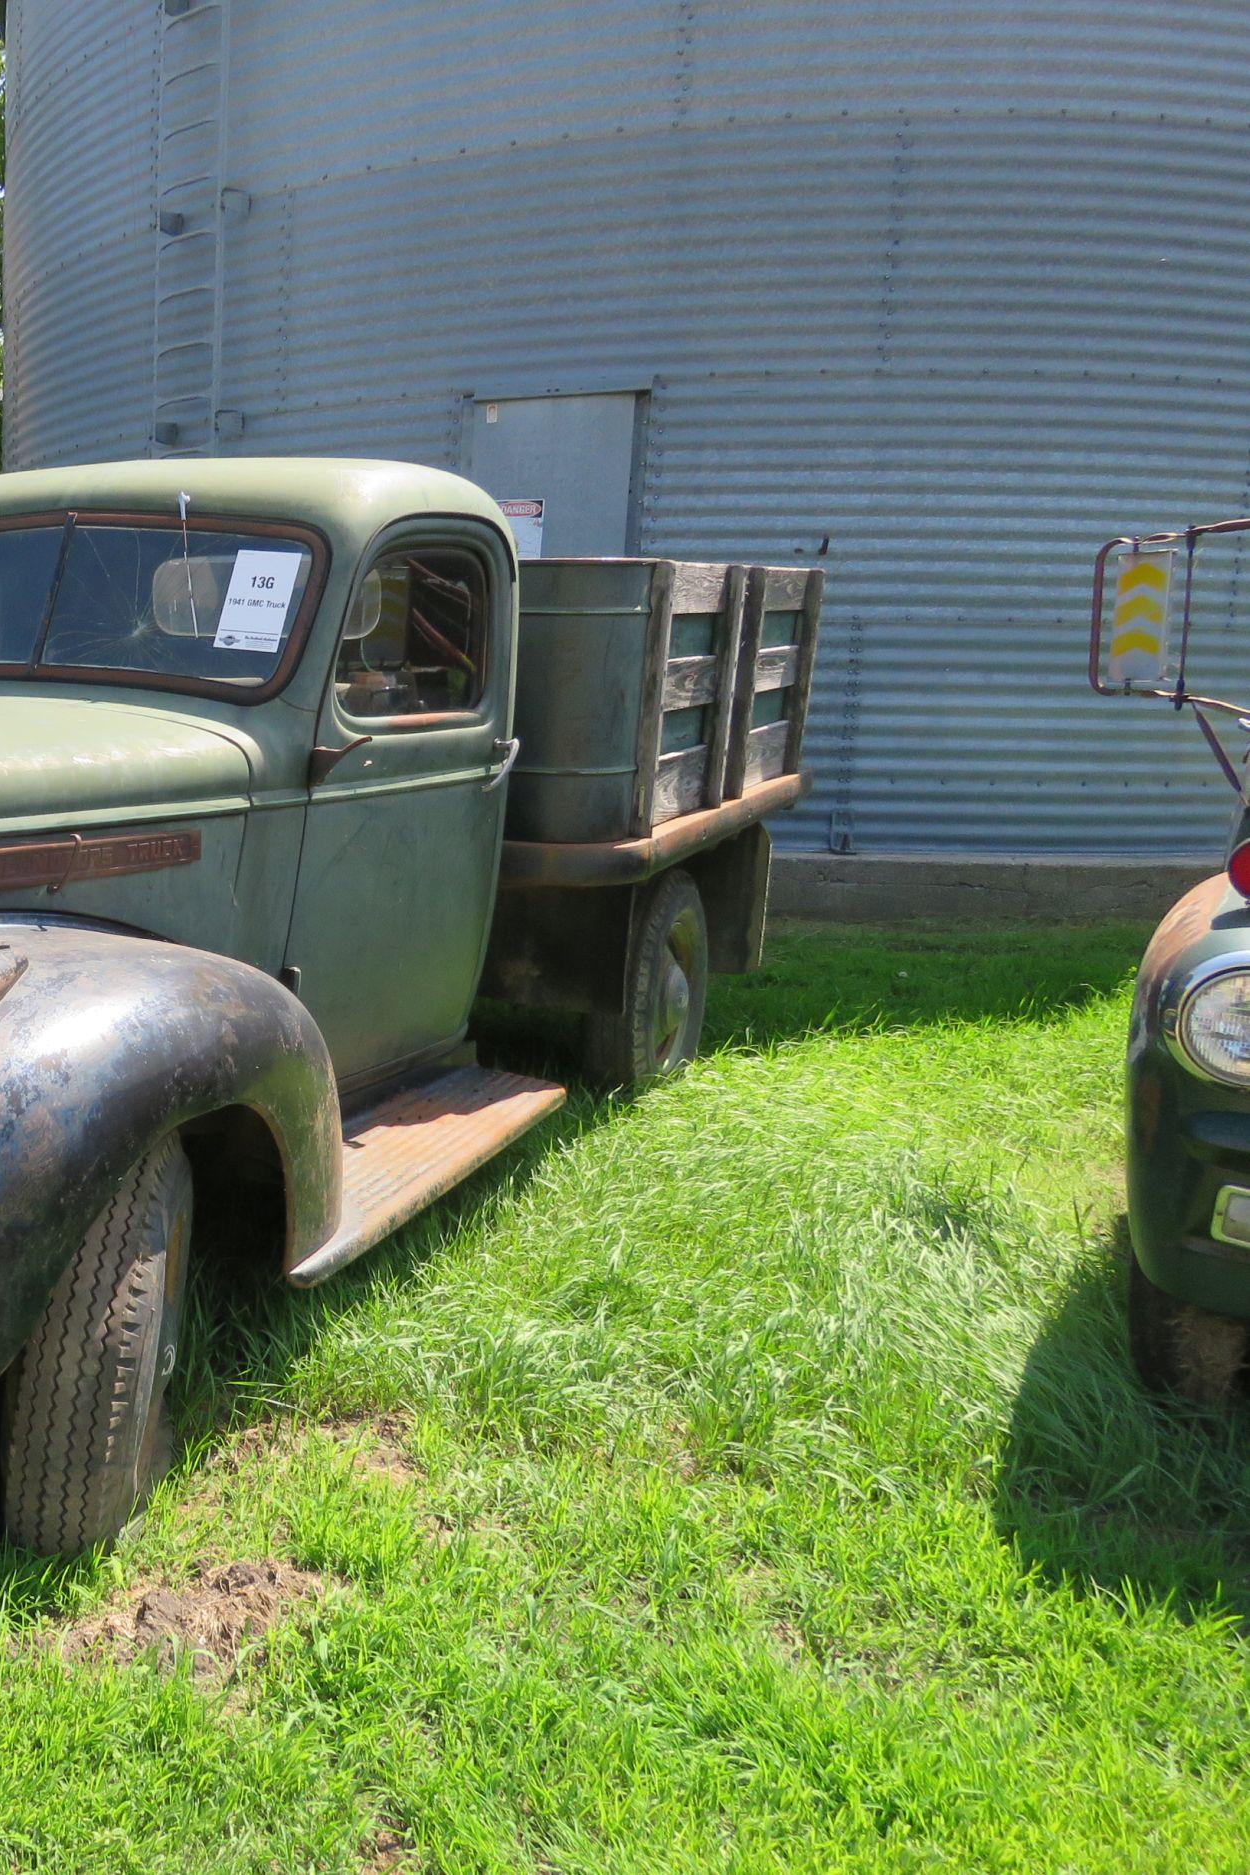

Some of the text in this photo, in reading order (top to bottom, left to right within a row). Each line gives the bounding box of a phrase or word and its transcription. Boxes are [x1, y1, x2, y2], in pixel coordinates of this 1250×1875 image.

[250, 575, 276, 590] 13G
[228, 597, 287, 610] 1941 GMC Truck
[126, 837, 186, 865] TRUCK
